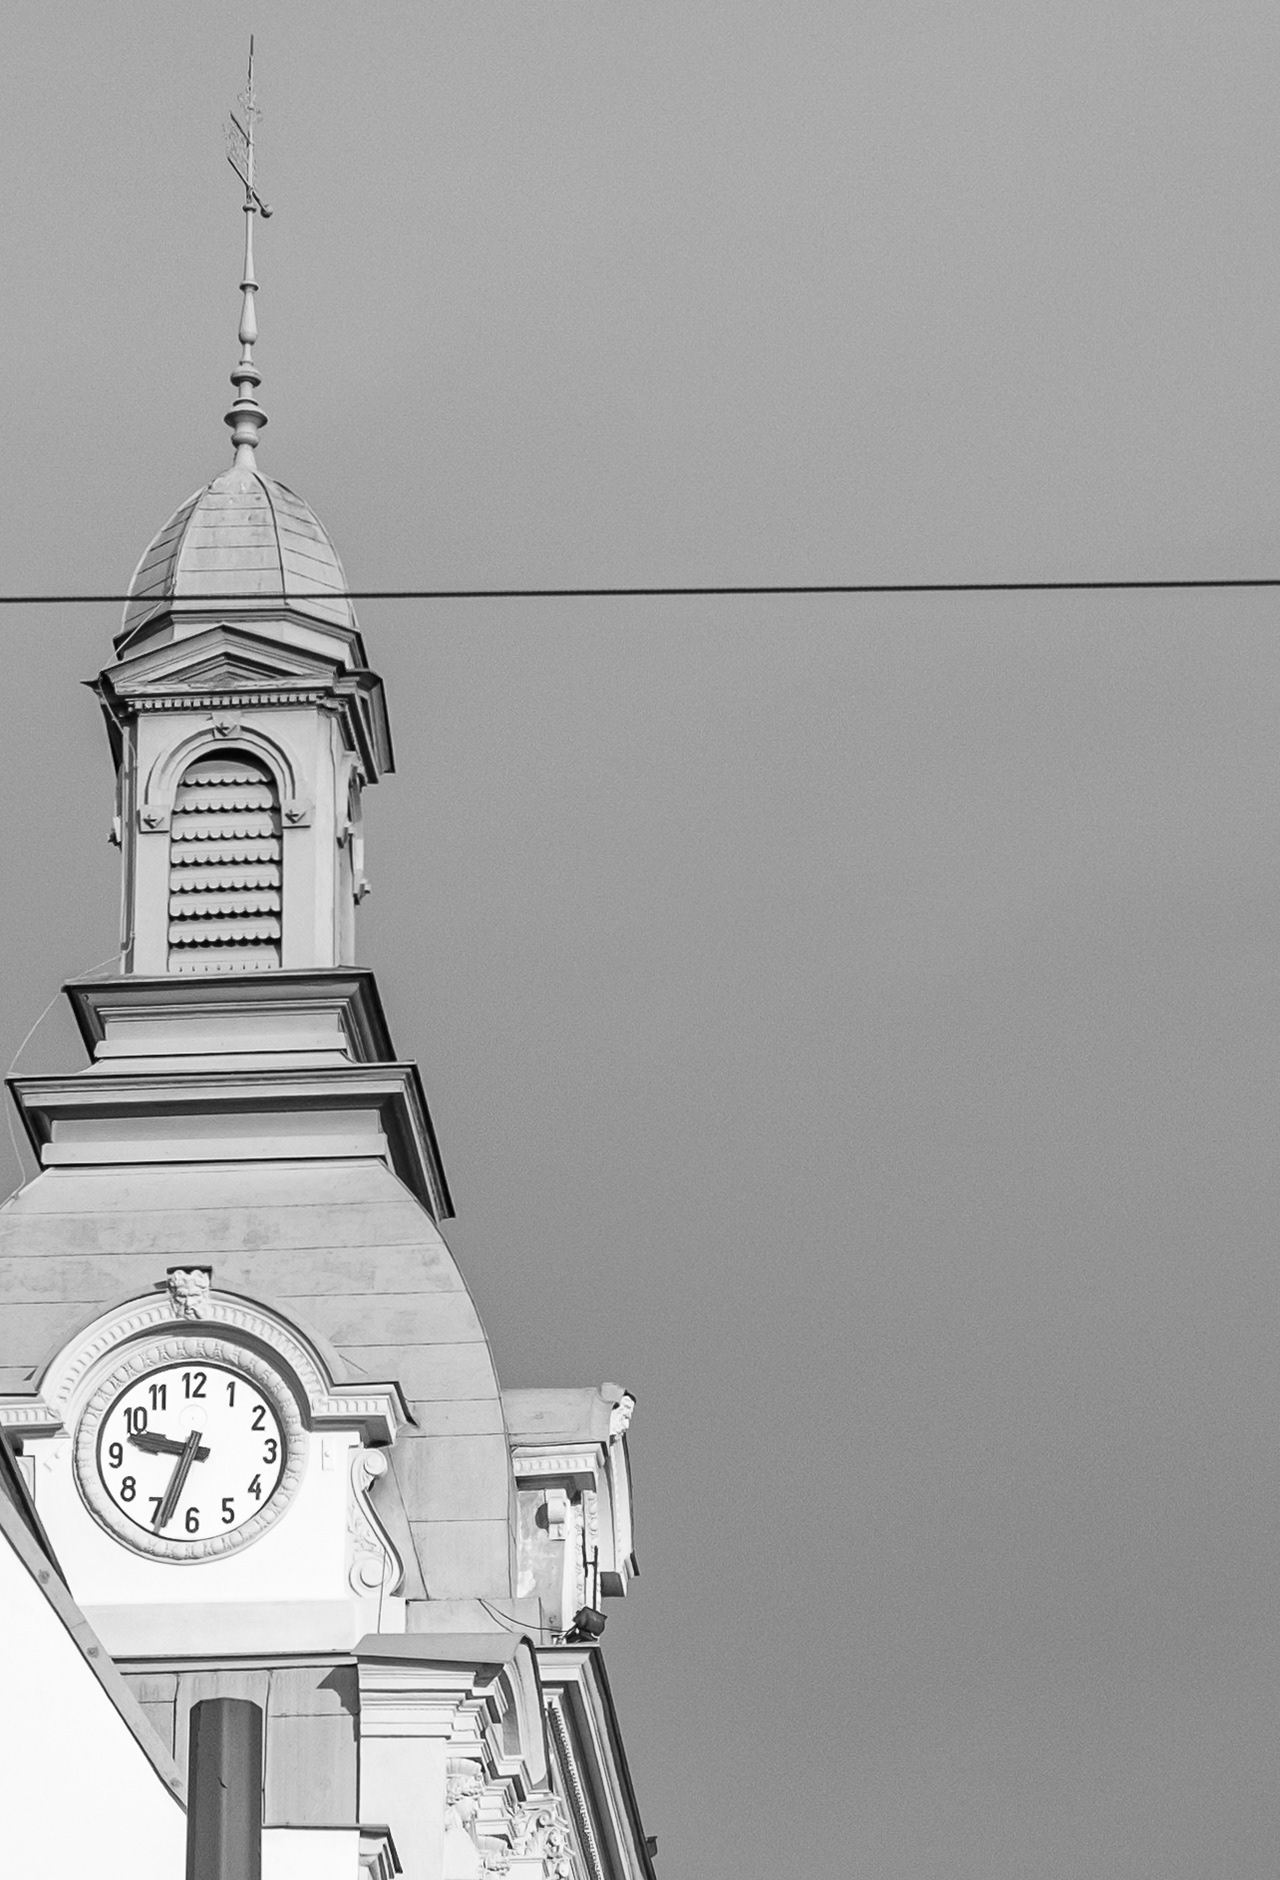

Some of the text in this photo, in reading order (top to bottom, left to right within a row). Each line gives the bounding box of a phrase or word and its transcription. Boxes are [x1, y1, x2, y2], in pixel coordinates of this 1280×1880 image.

[149, 1385, 167, 1410] 11
[182, 1373, 206, 1398] 12
[226, 1382, 236, 1407] 1
[123, 1407, 147, 1434] 10
[251, 1406, 265, 1431] 2
[108, 1442, 123, 1468] 9
[262, 1439, 277, 1464] 3
[120, 1476, 136, 1501] 8
[248, 1474, 261, 1499] 4
[185, 1507, 199, 1533] 6
[221, 1498, 235, 1523] 5
